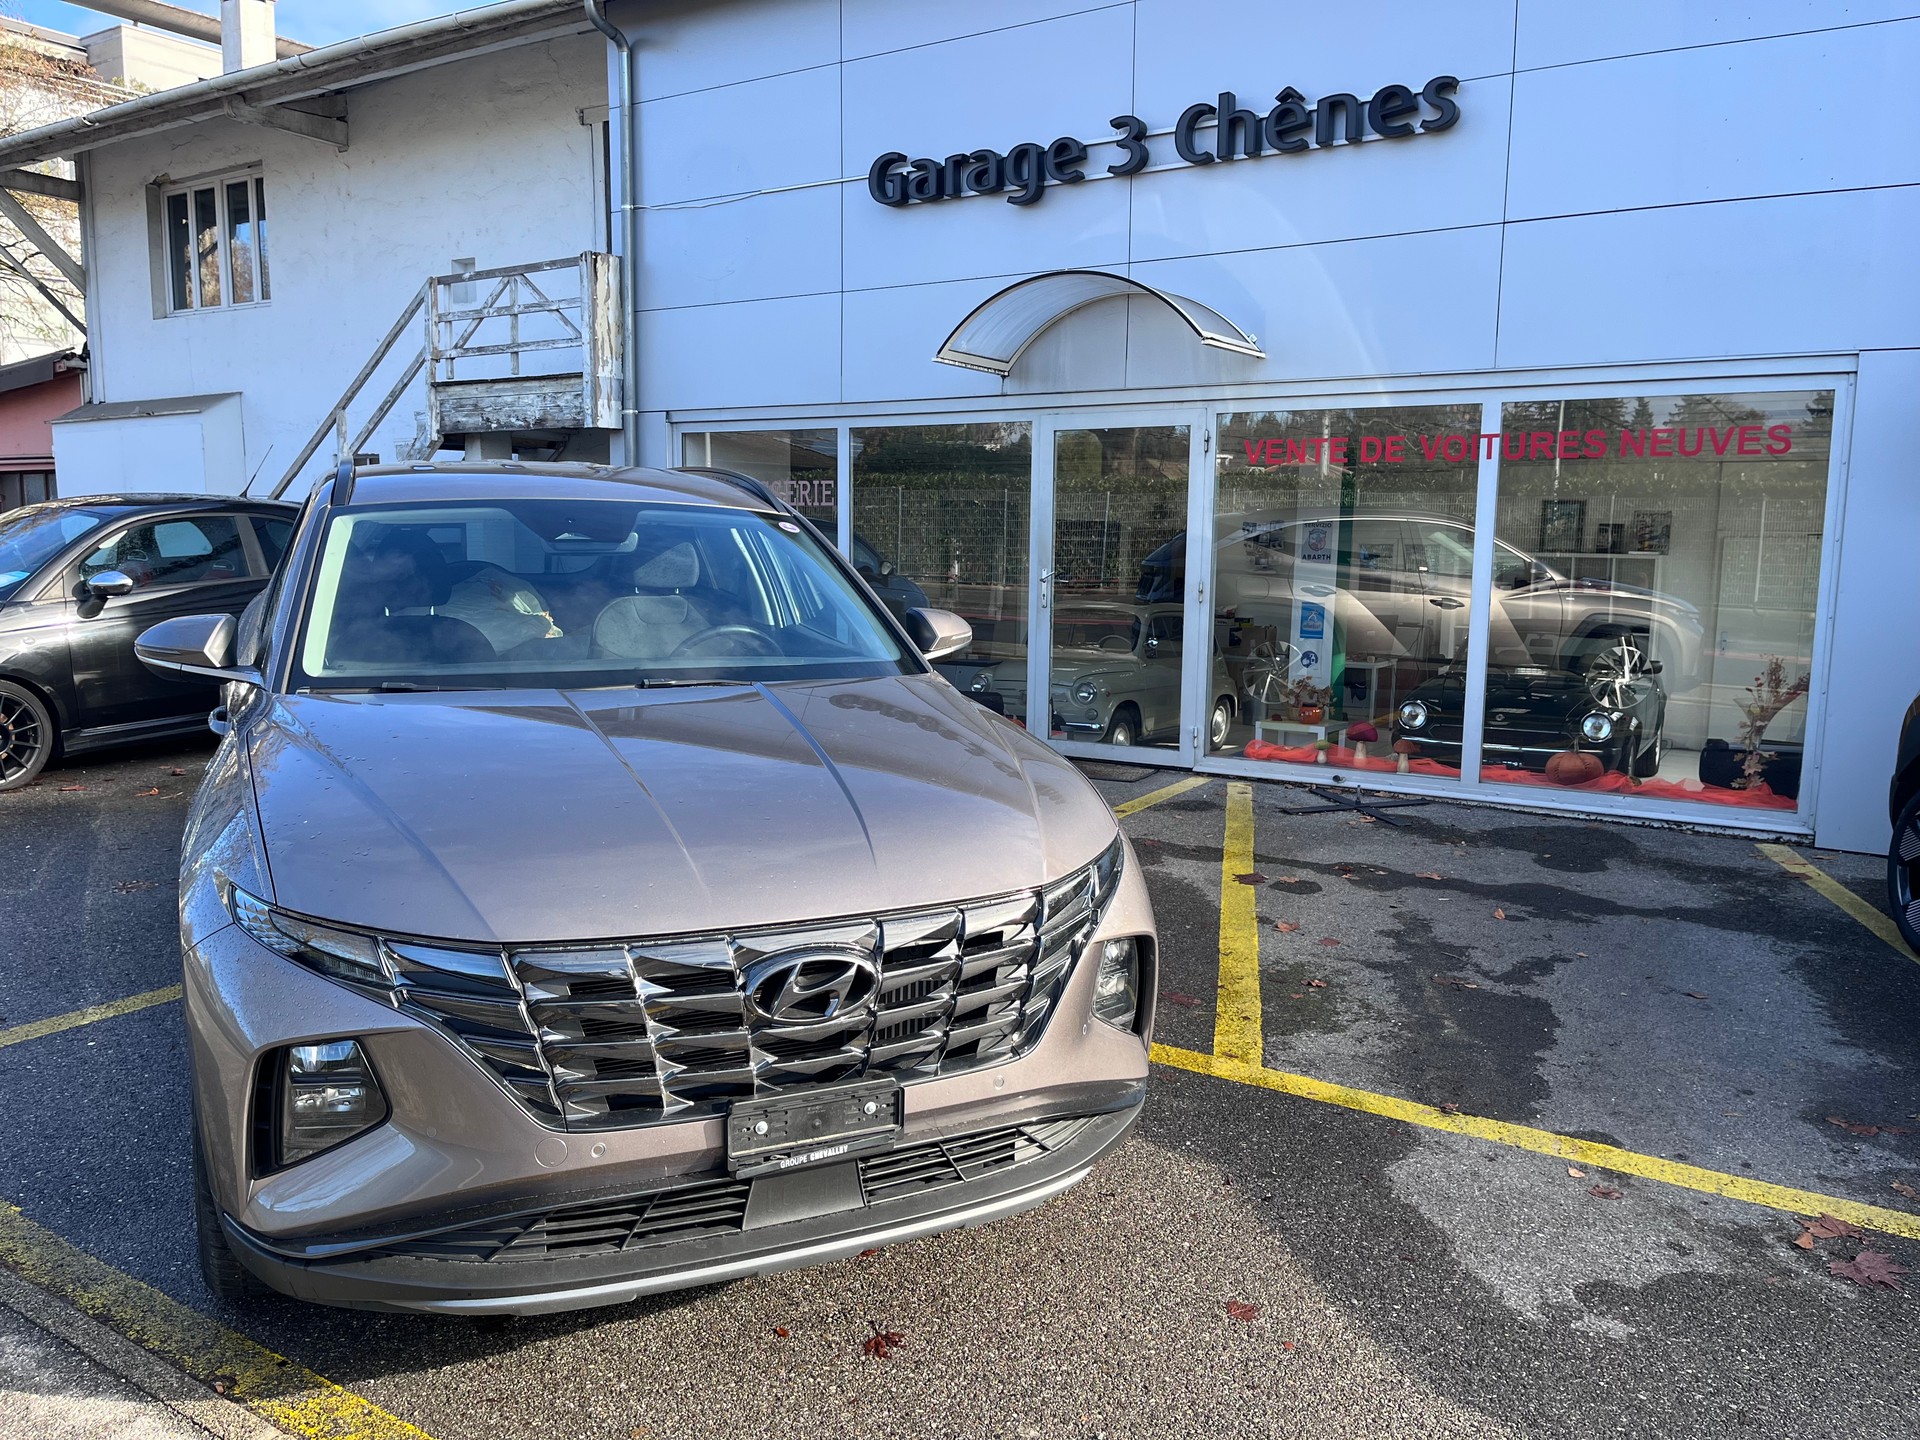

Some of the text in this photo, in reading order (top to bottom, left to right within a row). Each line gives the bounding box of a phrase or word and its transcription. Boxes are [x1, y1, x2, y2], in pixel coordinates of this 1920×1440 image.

[868, 75, 1460, 207] Garage 3 Chênes
[1243, 424, 1793, 464] VENTE DE VOITURES NEUVES
[780, 1154, 808, 1169] GROUPE
